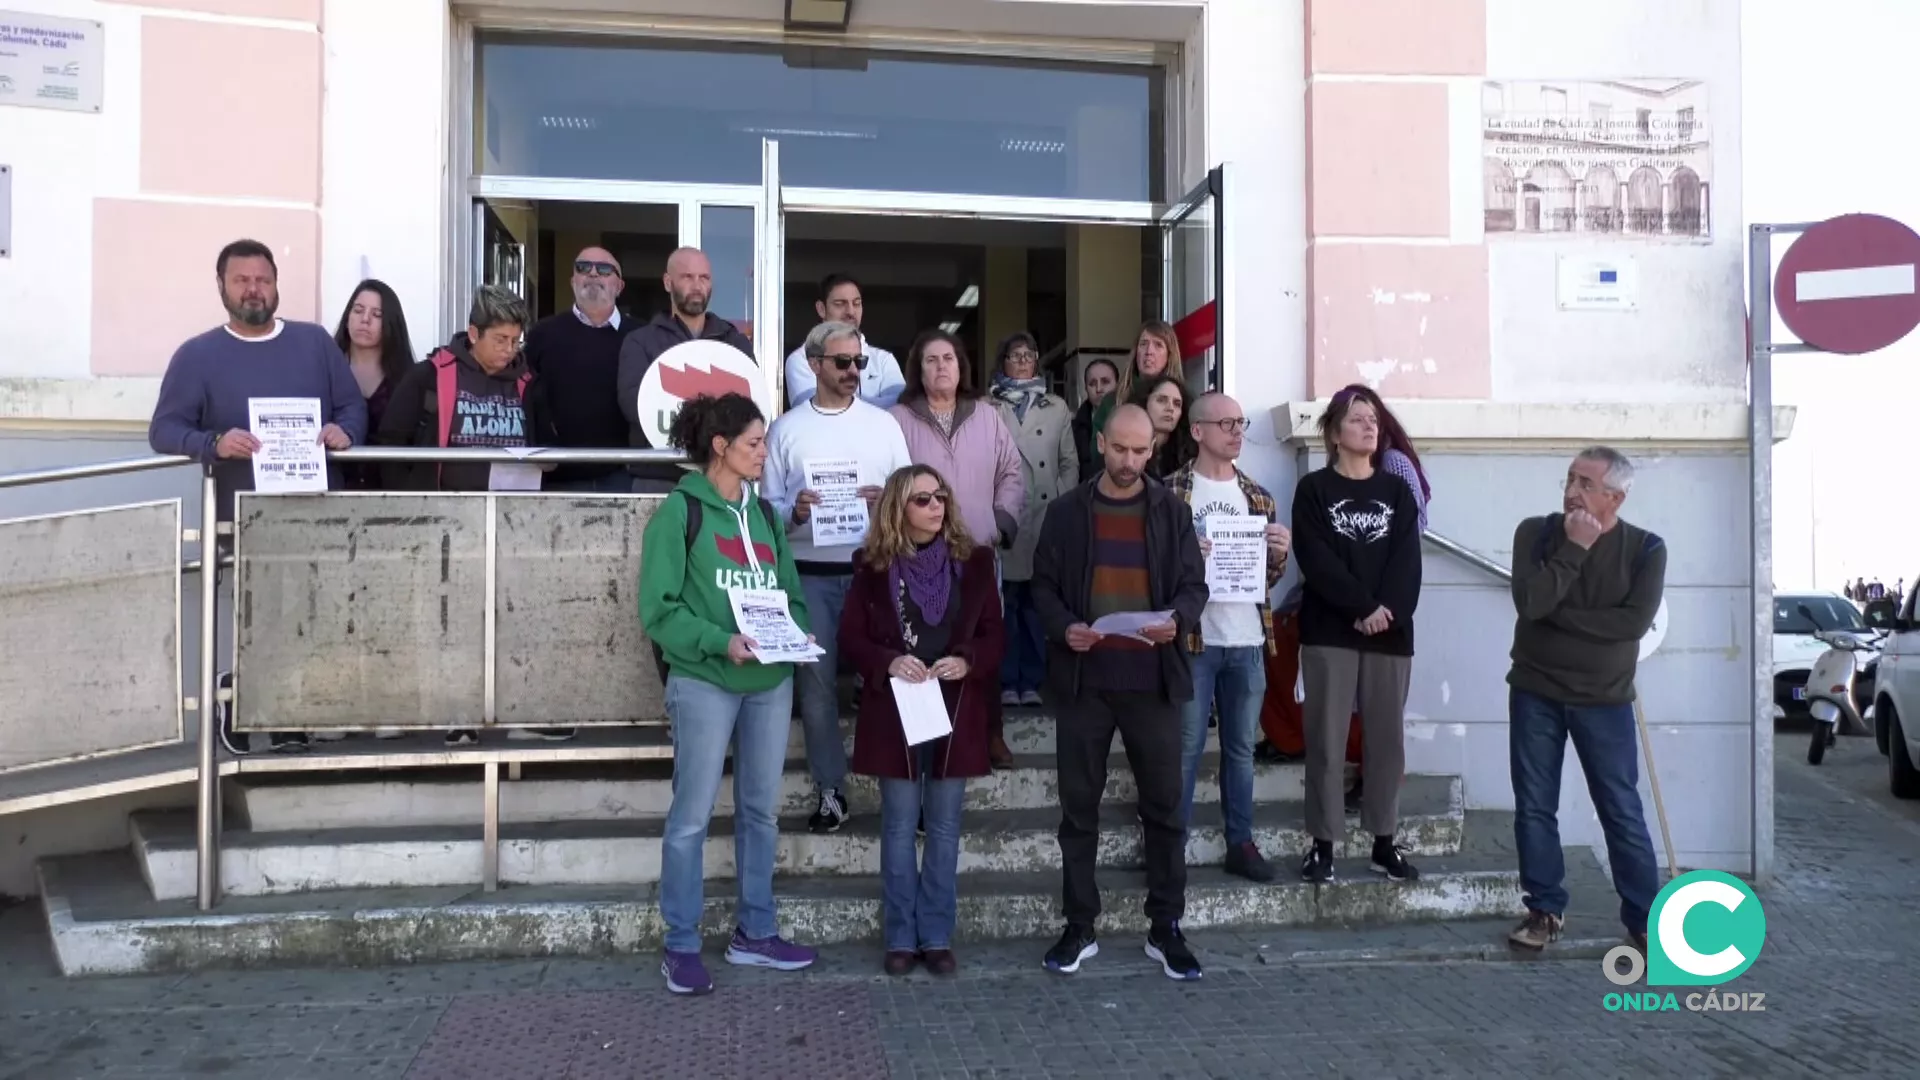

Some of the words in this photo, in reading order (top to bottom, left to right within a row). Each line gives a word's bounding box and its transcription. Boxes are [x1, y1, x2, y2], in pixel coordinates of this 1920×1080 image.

[1488, 117, 1501, 128] La
[1504, 117, 1540, 128] ciudad
[1543, 117, 1557, 128] de
[1592, 118, 1602, 128] al
[1651, 118, 1703, 129] Columela
[1499, 133, 1519, 142] con
[1522, 131, 1560, 142] motivo
[1561, 131, 1577, 141] del
[1583, 131, 1601, 141] 150
[1604, 132, 1661, 142] aniversario
[1664, 131, 1677, 142] de
[1546, 146, 1559, 154] en
[1563, 144, 1644, 154] reconocimiento
[1655, 143, 1666, 155] la
[1668, 143, 1696, 155] labor
[1503, 157, 1545, 168] docente
[1548, 159, 1567, 168] con
[1570, 157, 1585, 168] los
[458, 401, 495, 416] MADE
[461, 415, 524, 437] ALOHA
[715, 567, 778, 590] USTEA
